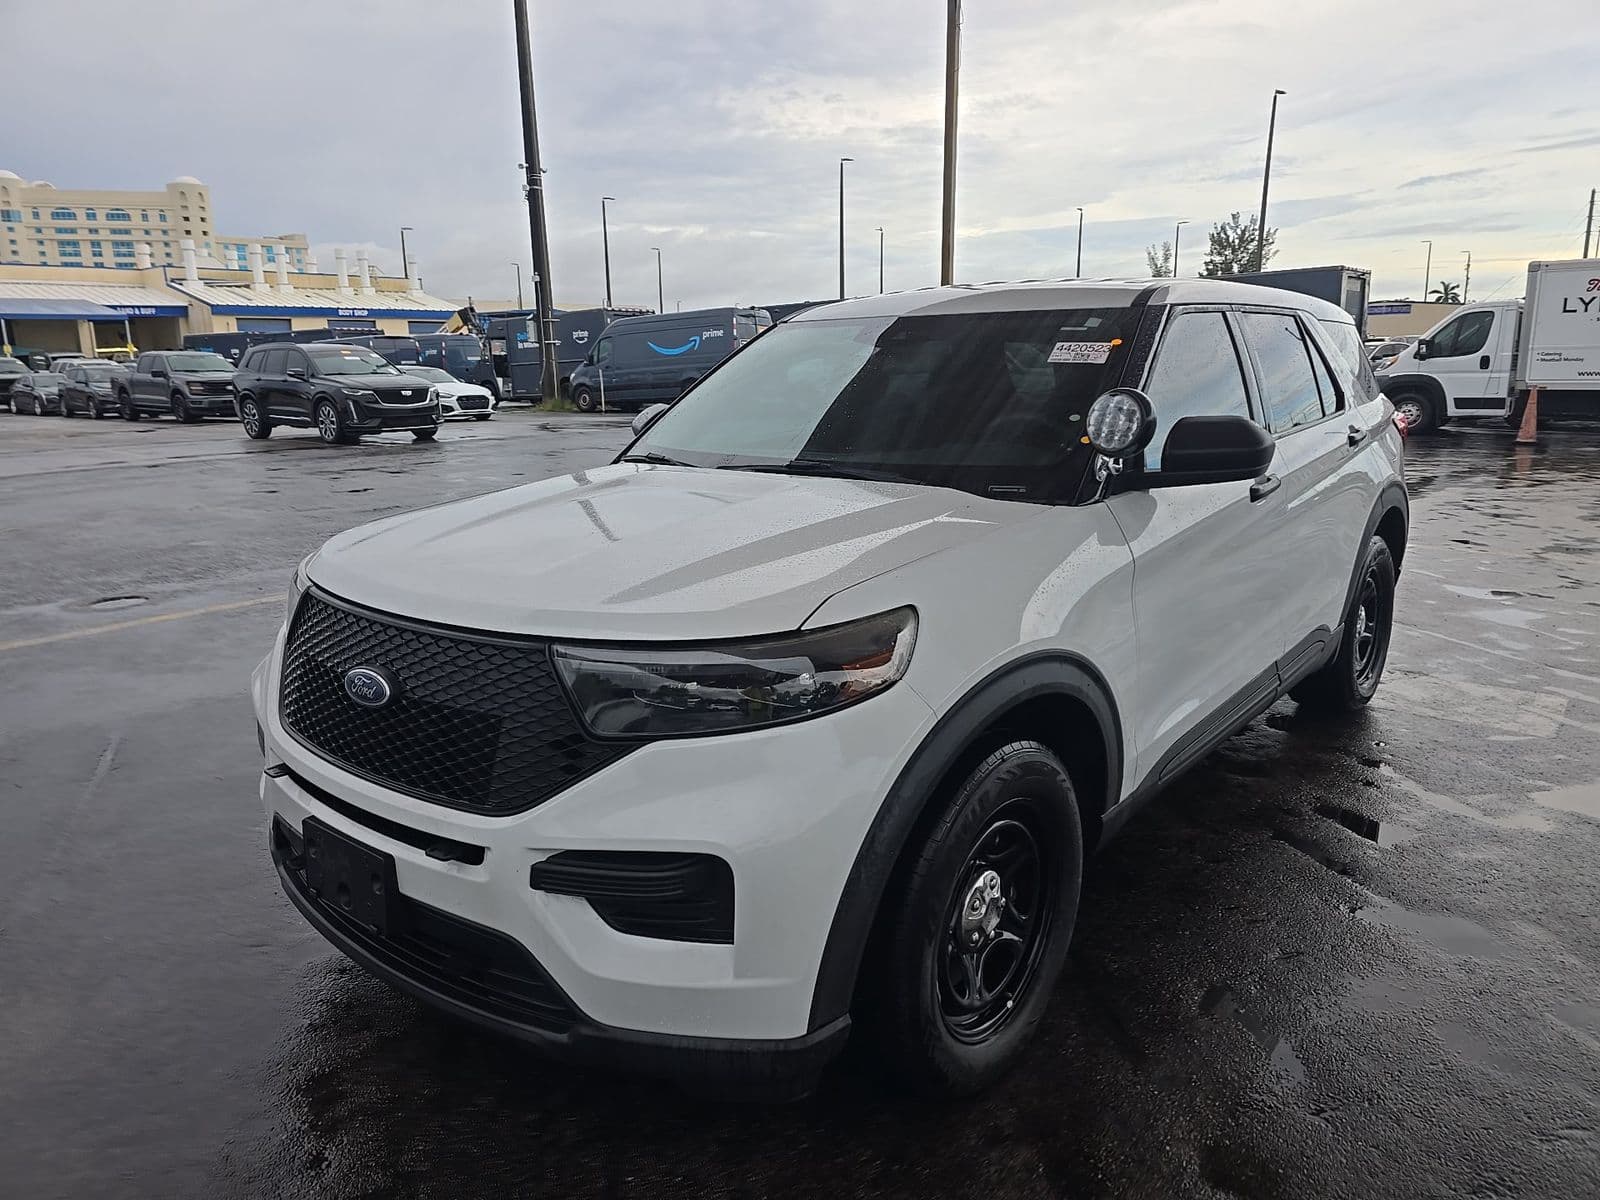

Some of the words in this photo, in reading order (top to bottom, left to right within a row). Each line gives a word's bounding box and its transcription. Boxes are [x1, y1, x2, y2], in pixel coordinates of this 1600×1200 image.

[1562, 296, 1600, 313] LY
[572, 330, 589, 339] prime
[702, 329, 724, 340] prime
[1056, 344, 1112, 353] 4420523
[351, 675, 377, 699] Ford
